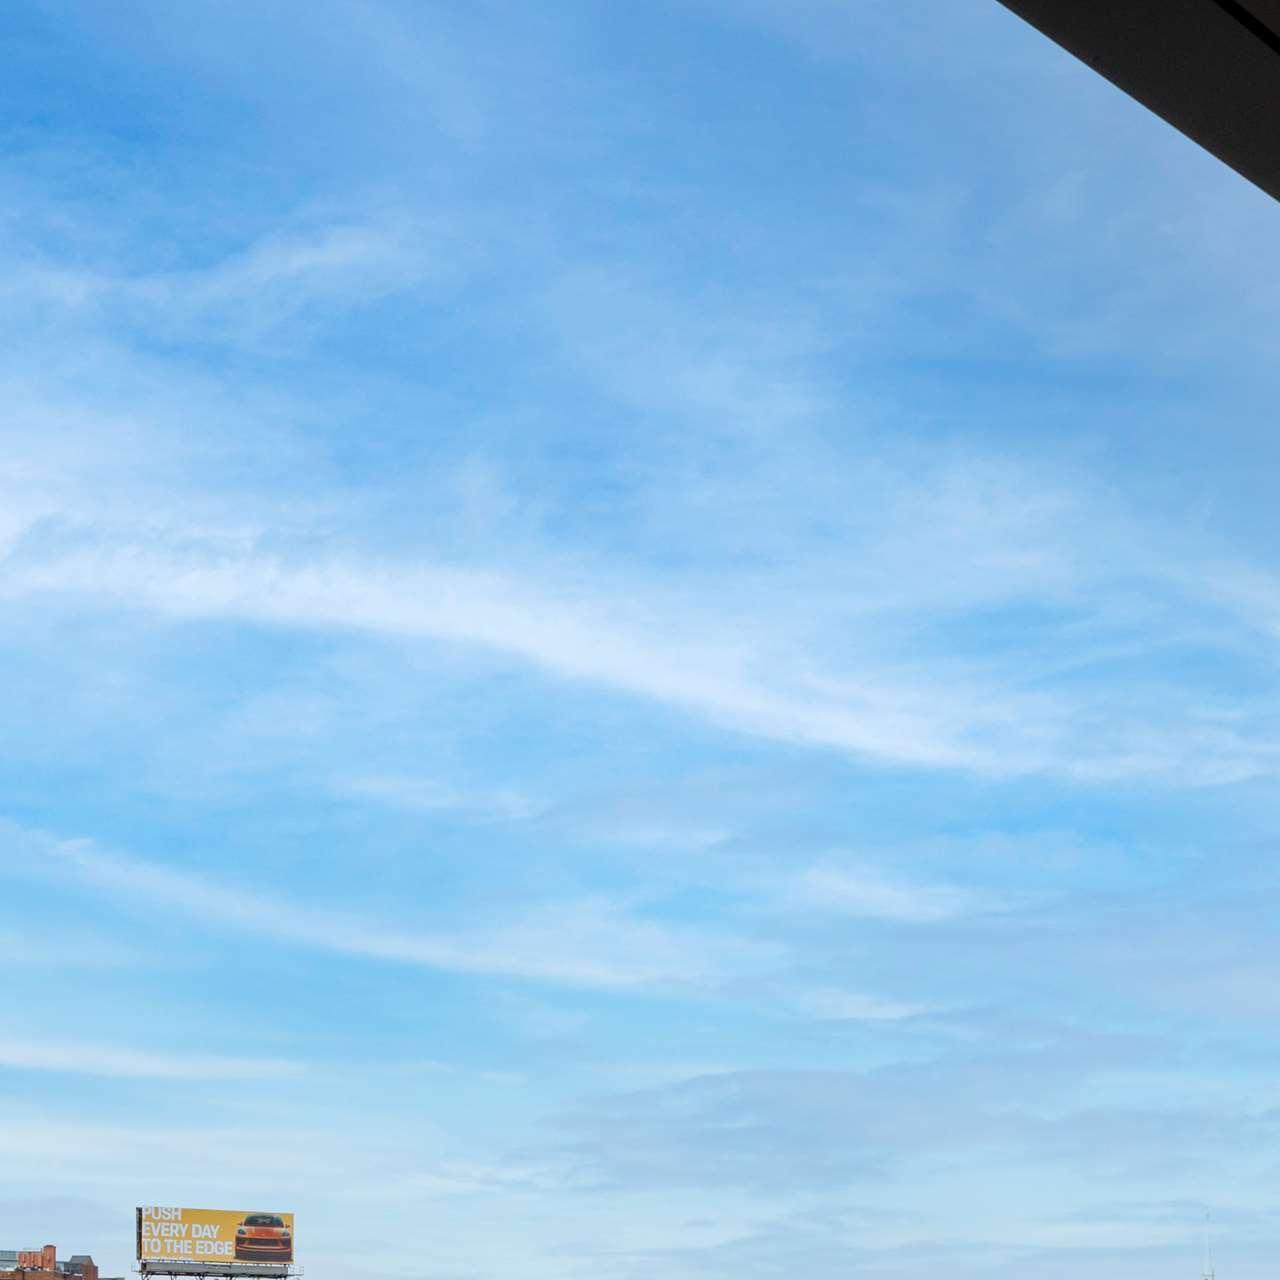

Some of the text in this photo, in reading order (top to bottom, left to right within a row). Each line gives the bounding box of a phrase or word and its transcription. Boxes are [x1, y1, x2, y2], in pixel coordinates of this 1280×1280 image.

[142, 1206, 182, 1221] PUSH
[142, 1222, 219, 1239] EVERY DAY
[142, 1239, 232, 1255] TO THE EDGE
